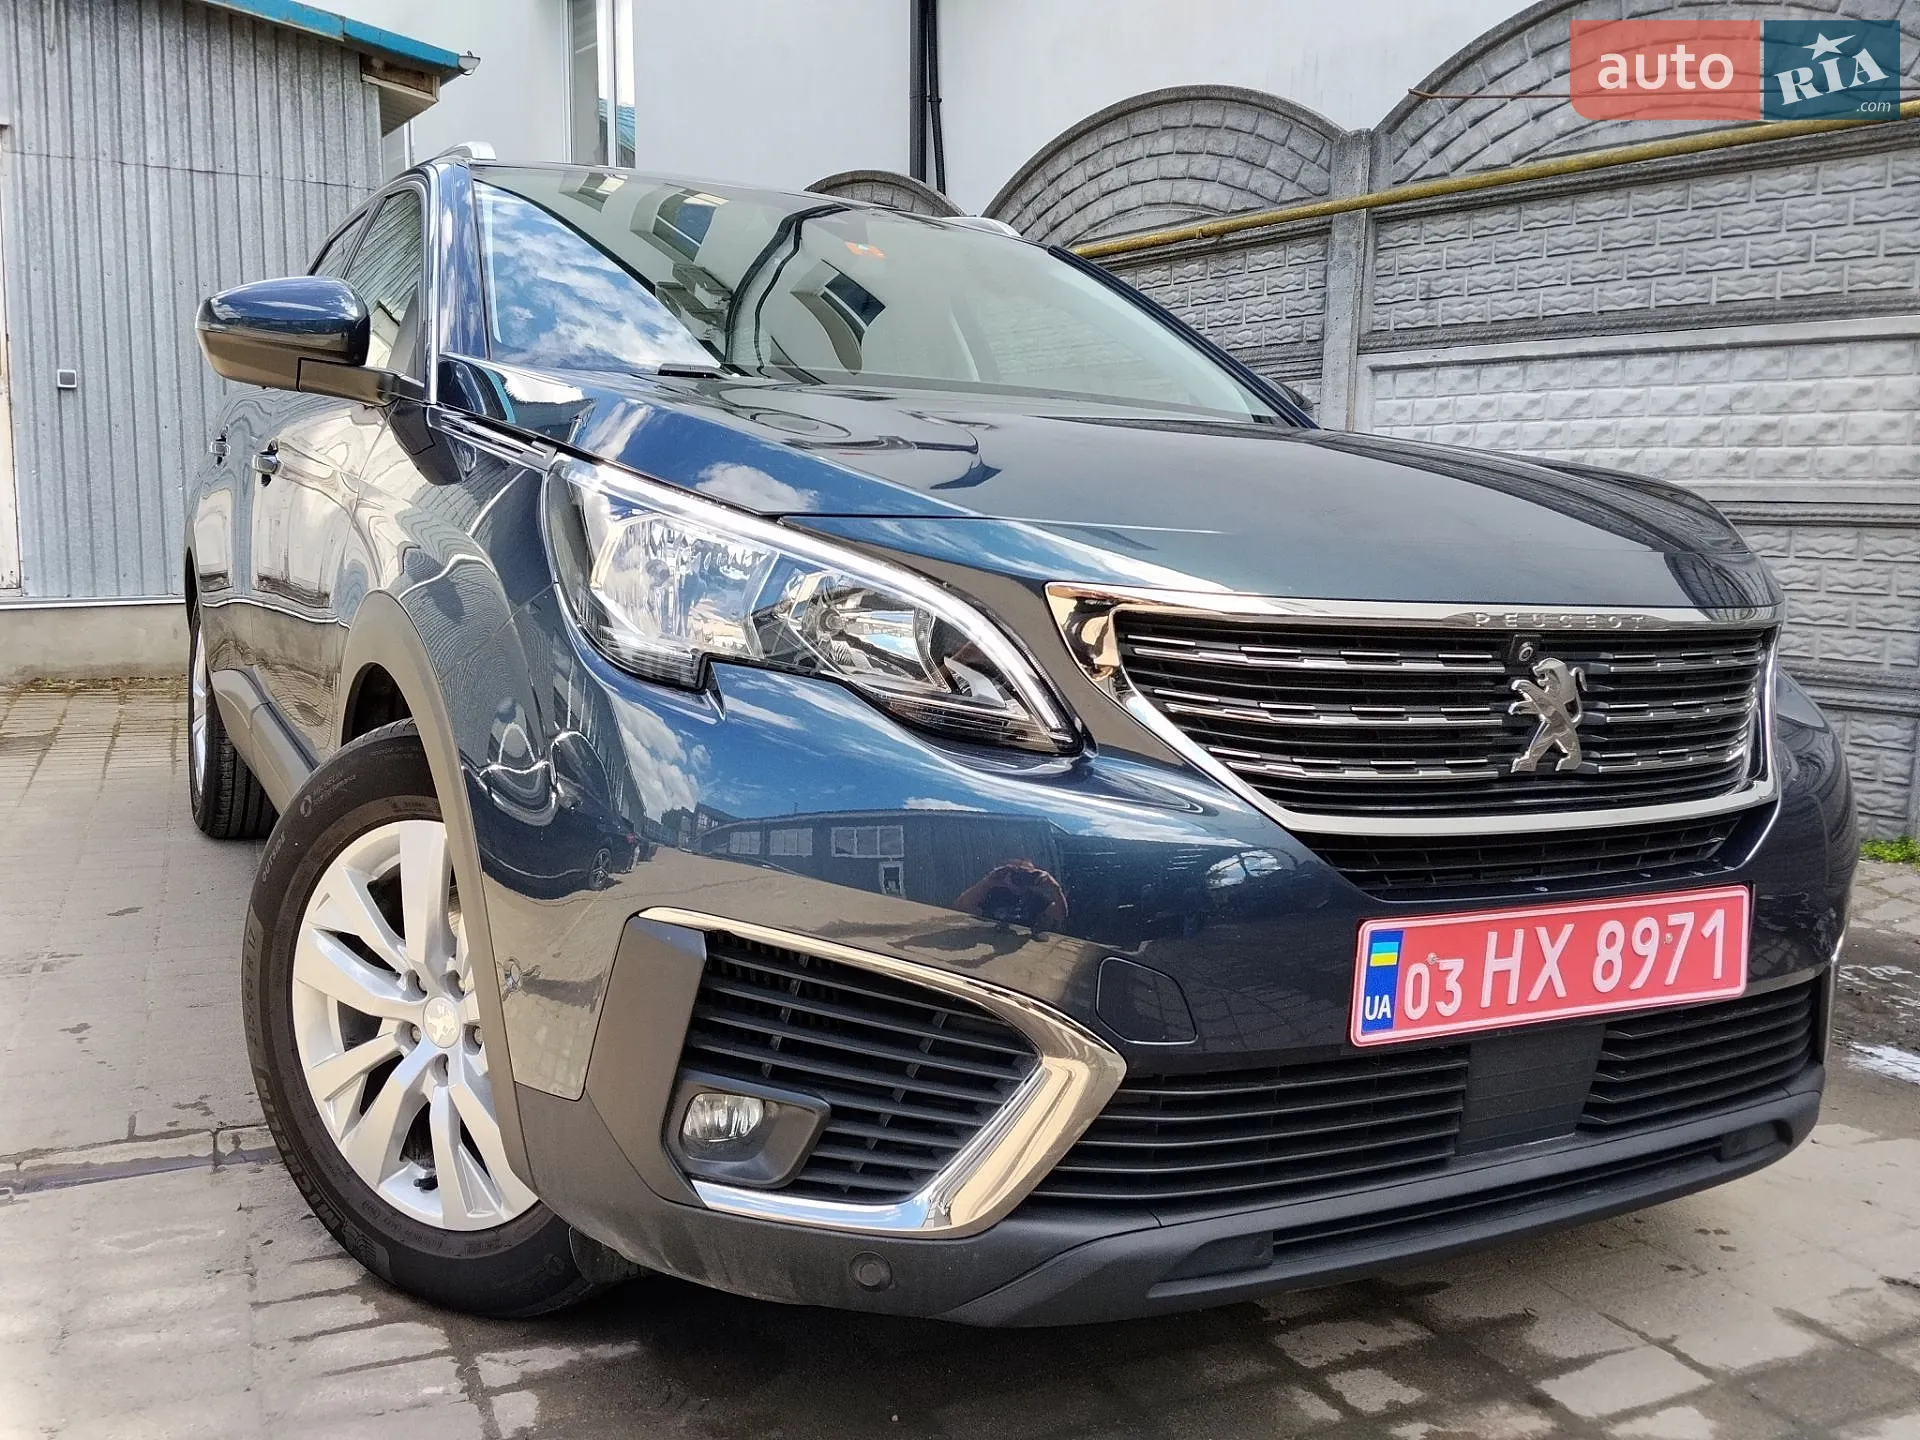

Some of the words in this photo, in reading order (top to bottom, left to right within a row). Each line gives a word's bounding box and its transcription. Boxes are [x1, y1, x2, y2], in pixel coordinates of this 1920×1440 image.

[1475, 613, 1644, 631] PEUGEOT
[1404, 959, 1464, 1021] 03
[1480, 923, 1575, 1009] HX
[1592, 908, 1725, 993] 8971
[1365, 996, 1392, 1021] UA
